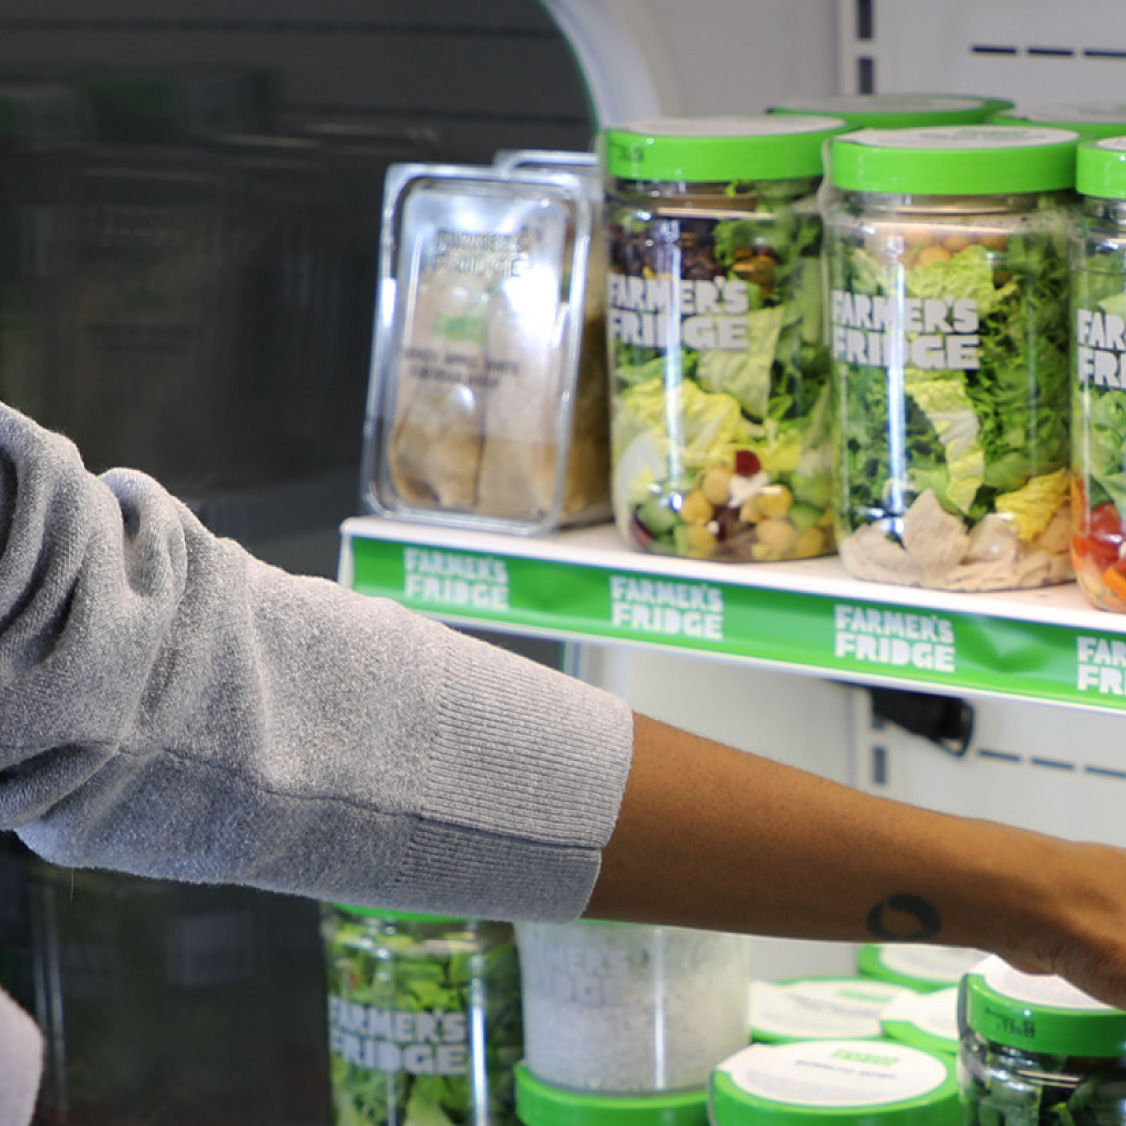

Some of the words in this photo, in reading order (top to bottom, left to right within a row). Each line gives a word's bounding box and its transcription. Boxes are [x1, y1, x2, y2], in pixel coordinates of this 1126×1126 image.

[606, 273, 749, 315] FARMER'S
[831, 289, 980, 334] FARMER'S
[606, 308, 749, 350] FRIDGE
[831, 331, 981, 371] FRIDGE
[404, 547, 508, 583] FARMER'S
[404, 572, 509, 610] FRIDGE
[610, 576, 724, 613] FARMER'S
[610, 599, 724, 640] FRIDGE
[835, 603, 955, 645] FARMER'S
[834, 628, 956, 673] FRIDGE
[330, 996, 467, 1043] FARMER'S
[330, 1029, 467, 1076] FRIDGE
